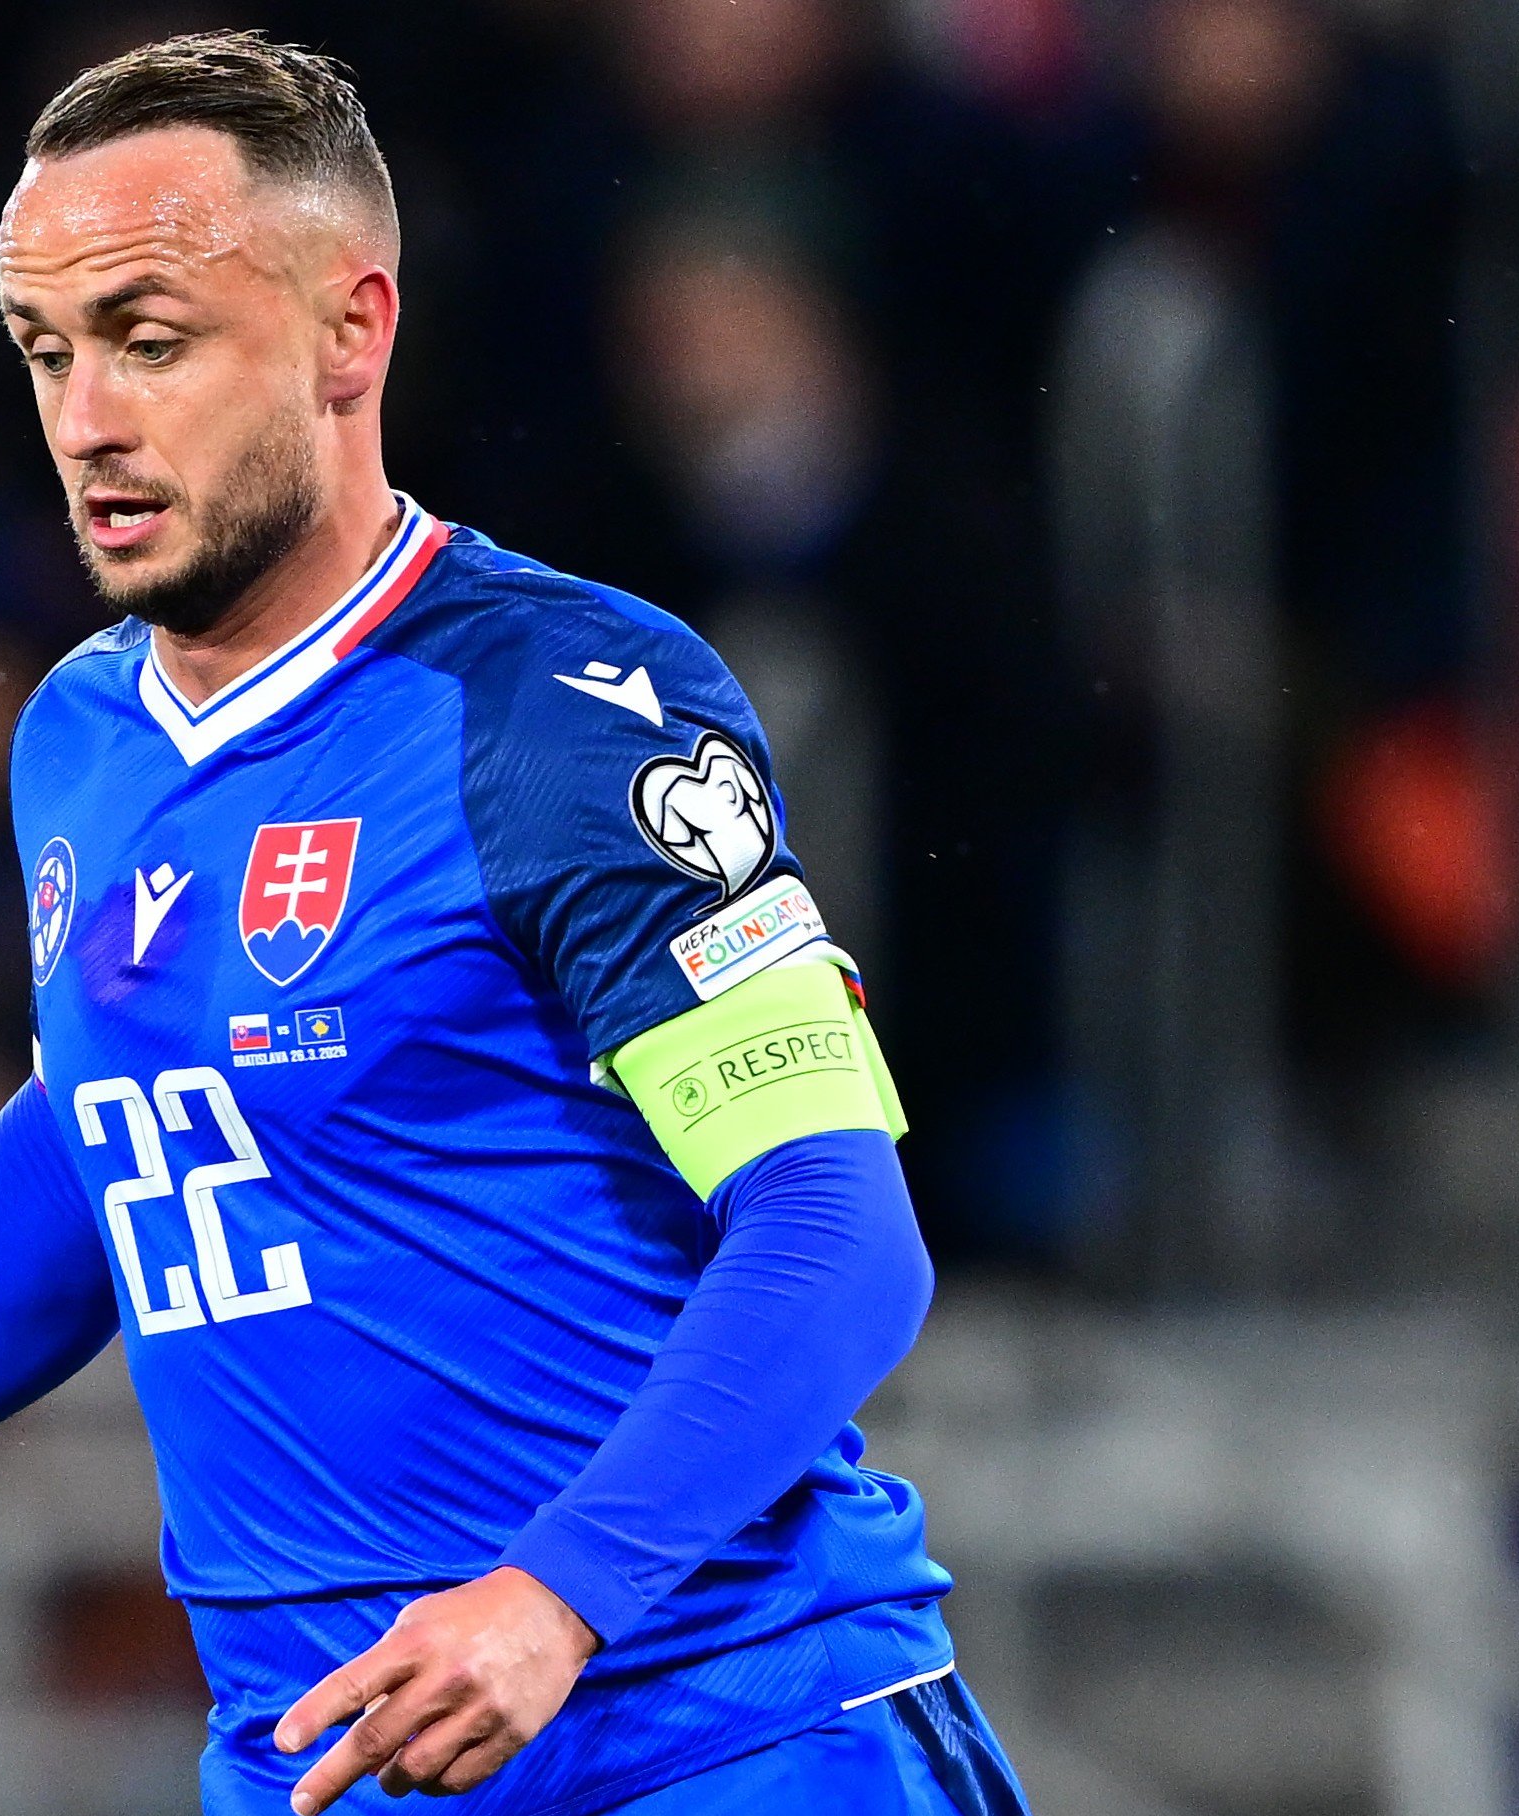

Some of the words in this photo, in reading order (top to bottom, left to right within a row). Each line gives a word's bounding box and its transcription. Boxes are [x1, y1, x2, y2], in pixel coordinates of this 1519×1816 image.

[678, 923, 721, 955] UEFA
[233, 1050, 289, 1067] BRATISLAVA
[717, 1031, 852, 1090] RESPECT
[73, 1066, 313, 1336] 22
